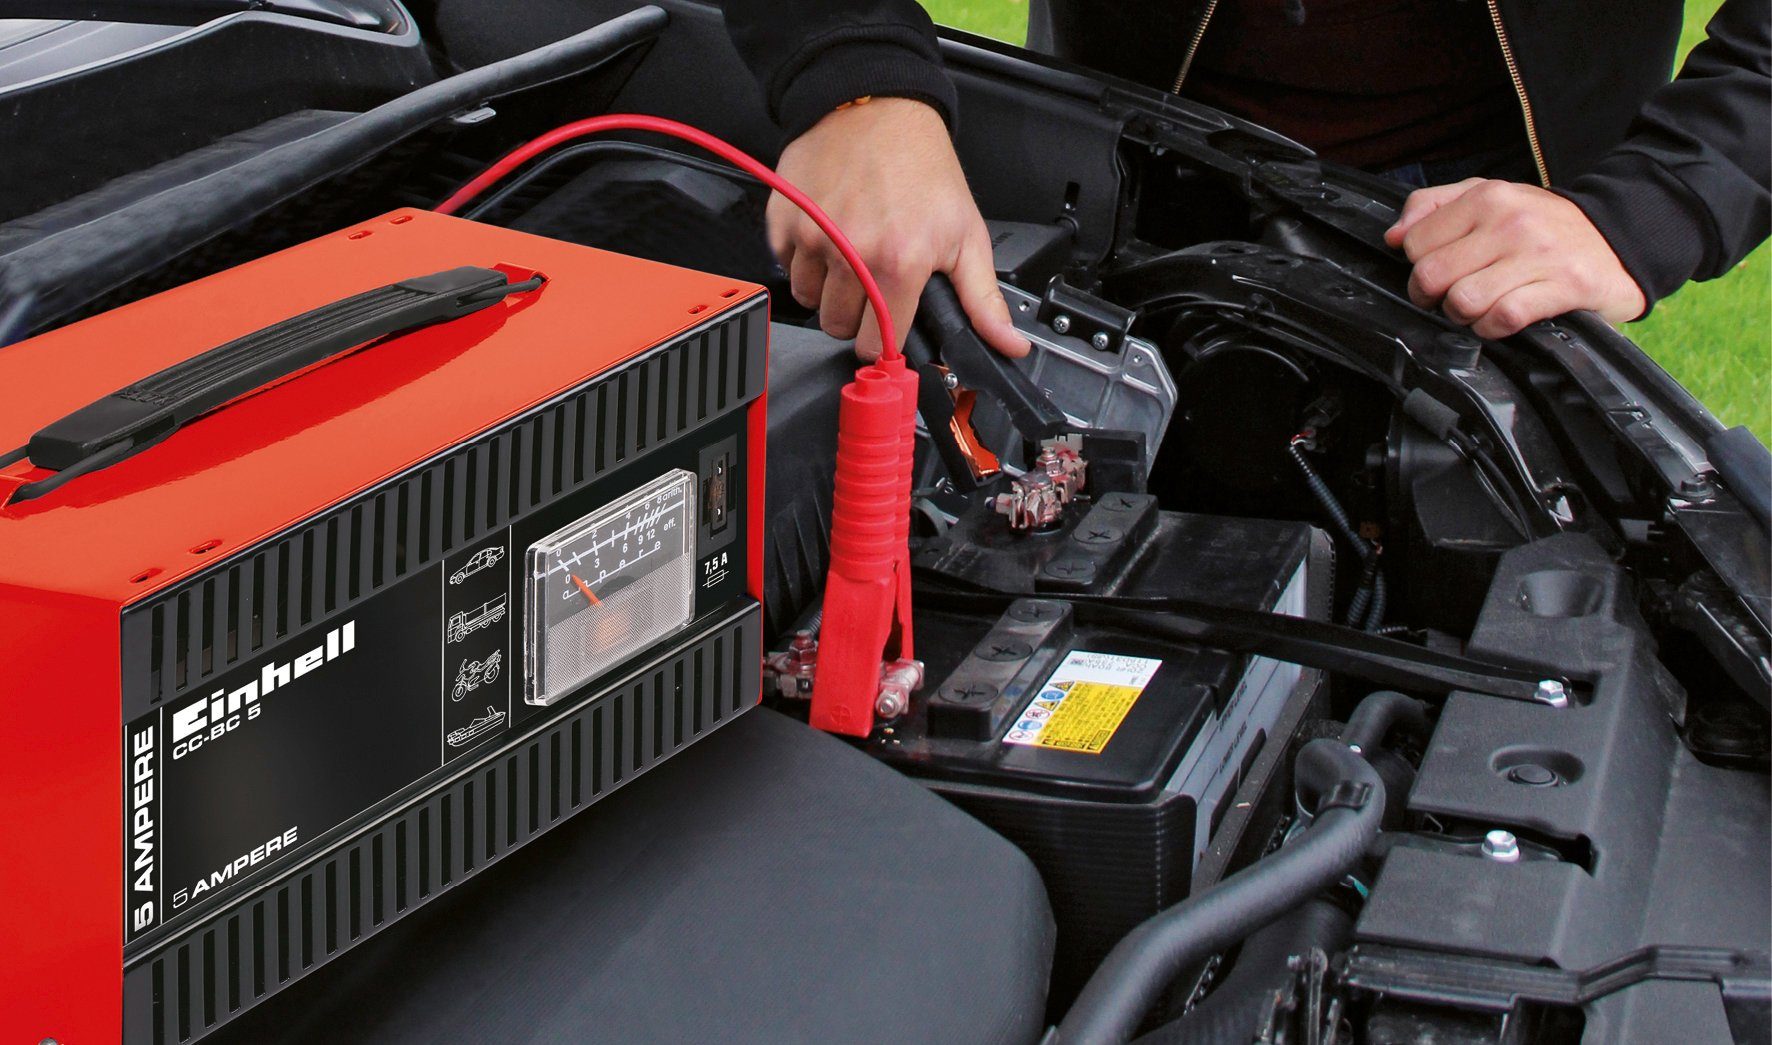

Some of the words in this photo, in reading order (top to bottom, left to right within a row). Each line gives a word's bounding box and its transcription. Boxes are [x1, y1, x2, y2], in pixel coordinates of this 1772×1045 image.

[565, 573, 571, 584] 0
[594, 557, 600, 569] 3
[622, 542, 628, 553] 6
[638, 534, 644, 545] 9
[646, 528, 656, 541] 12
[664, 517, 676, 531] eff.
[591, 528, 598, 540] 2
[704, 556, 719, 575] 7,5
[721, 551, 728, 566] A
[173, 619, 355, 744] Einhell
[172, 714, 241, 761] CC-BC
[247, 702, 261, 721] 5
[134, 725, 154, 892] AMPERE
[172, 887, 189, 909] 5
[191, 825, 298, 900] AMPERE
[134, 900, 154, 932] 5
